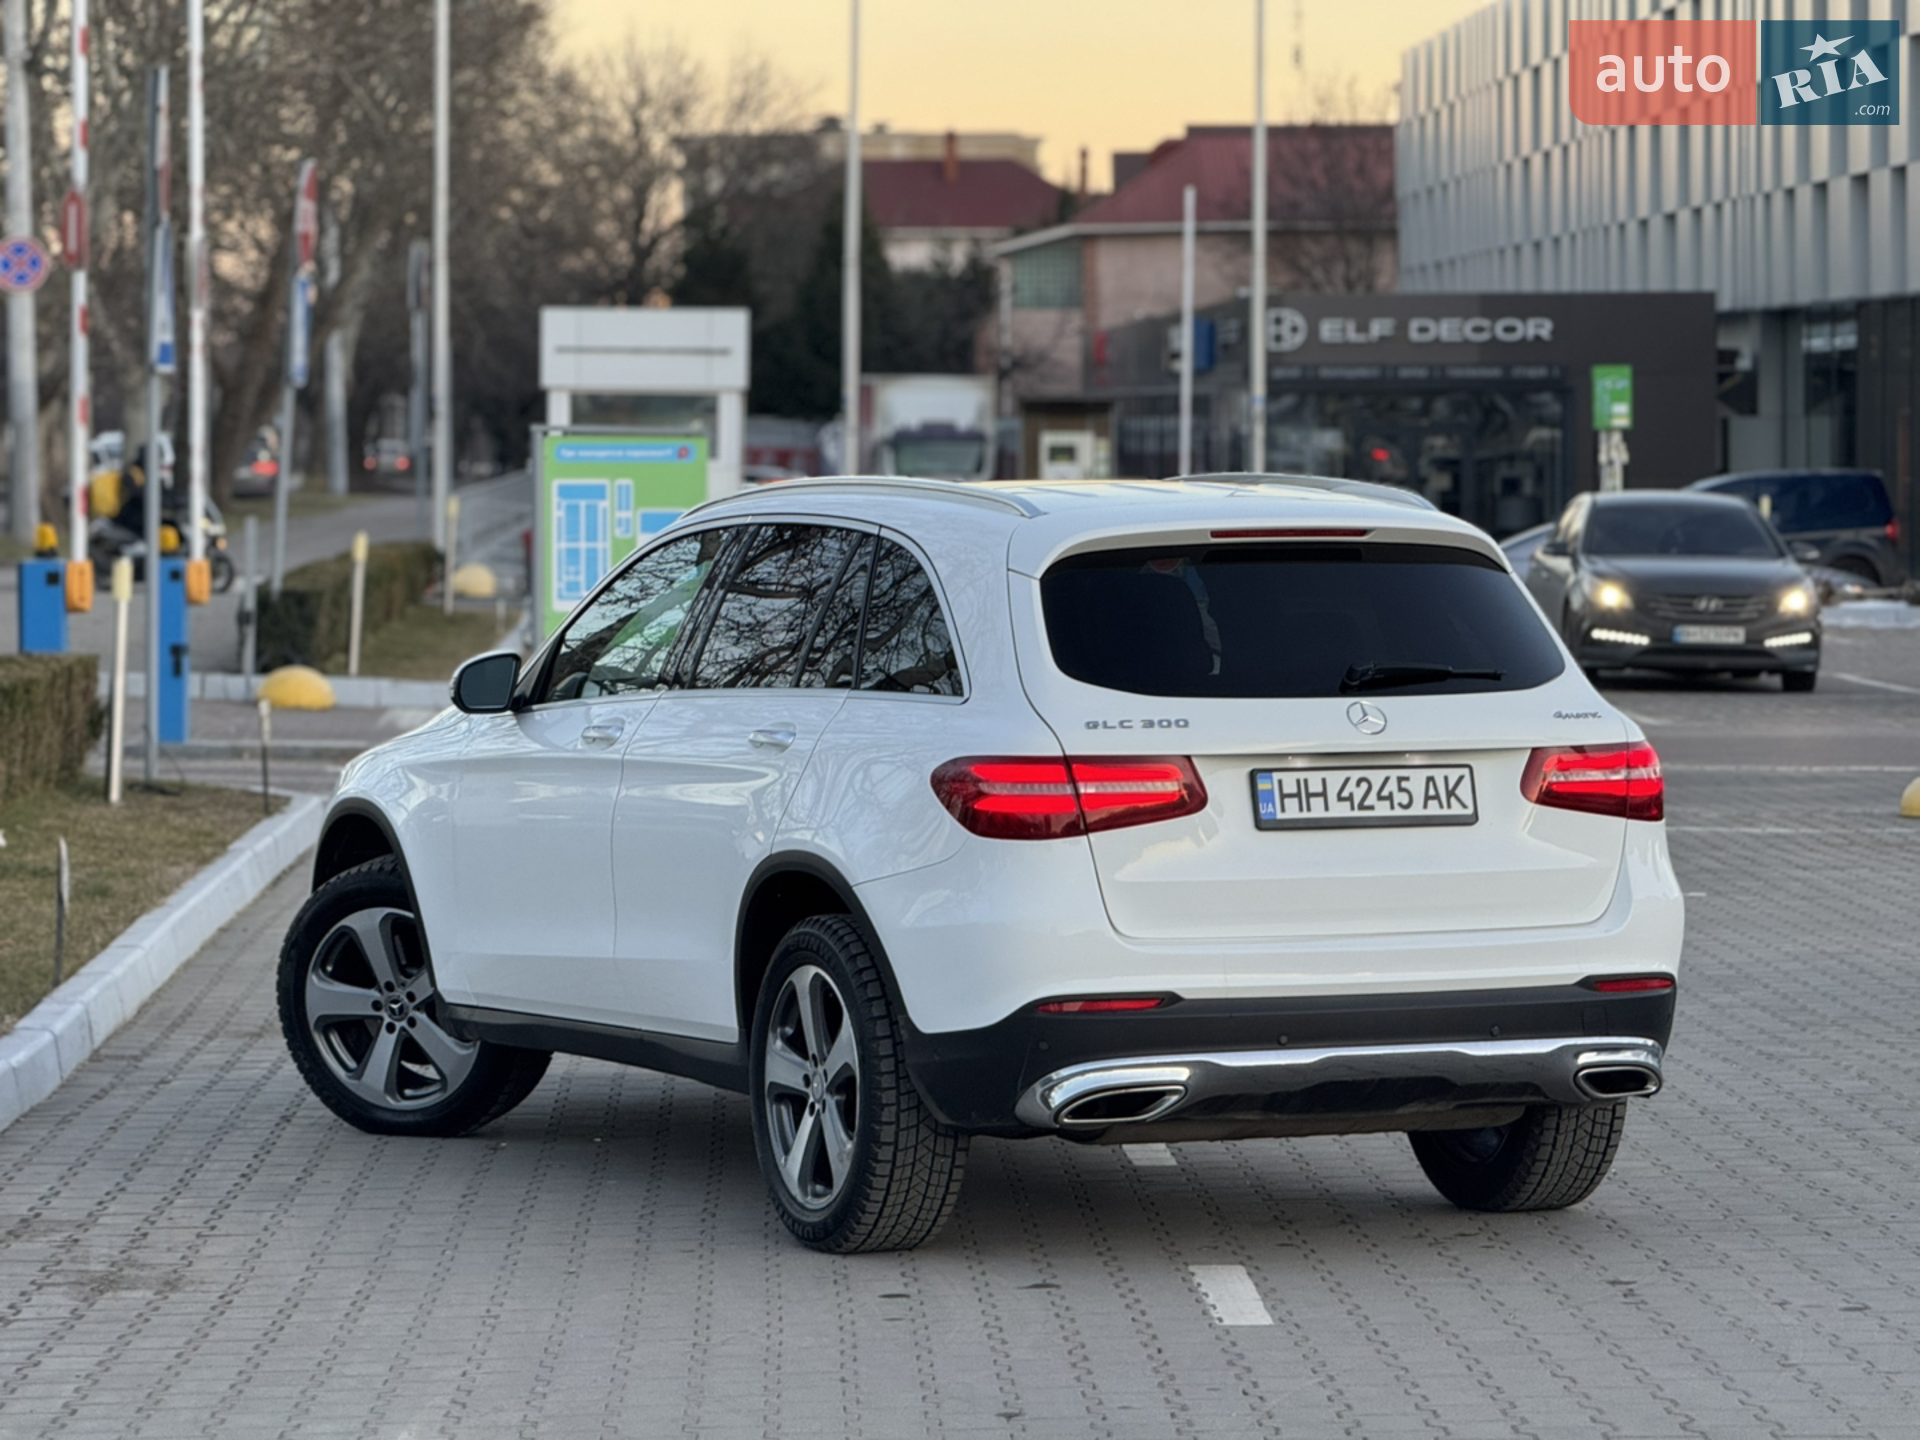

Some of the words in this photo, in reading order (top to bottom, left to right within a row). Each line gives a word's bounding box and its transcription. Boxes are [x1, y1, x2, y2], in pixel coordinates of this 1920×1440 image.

[1318, 317, 1397, 343] ELF
[1407, 317, 1554, 342] DECOR
[1084, 719, 1134, 730] GLC
[1140, 718, 1190, 729] 300
[1277, 777, 1330, 813] HH
[1336, 775, 1414, 811] 4245
[1422, 774, 1469, 809] AK
[1260, 802, 1275, 814] UA
